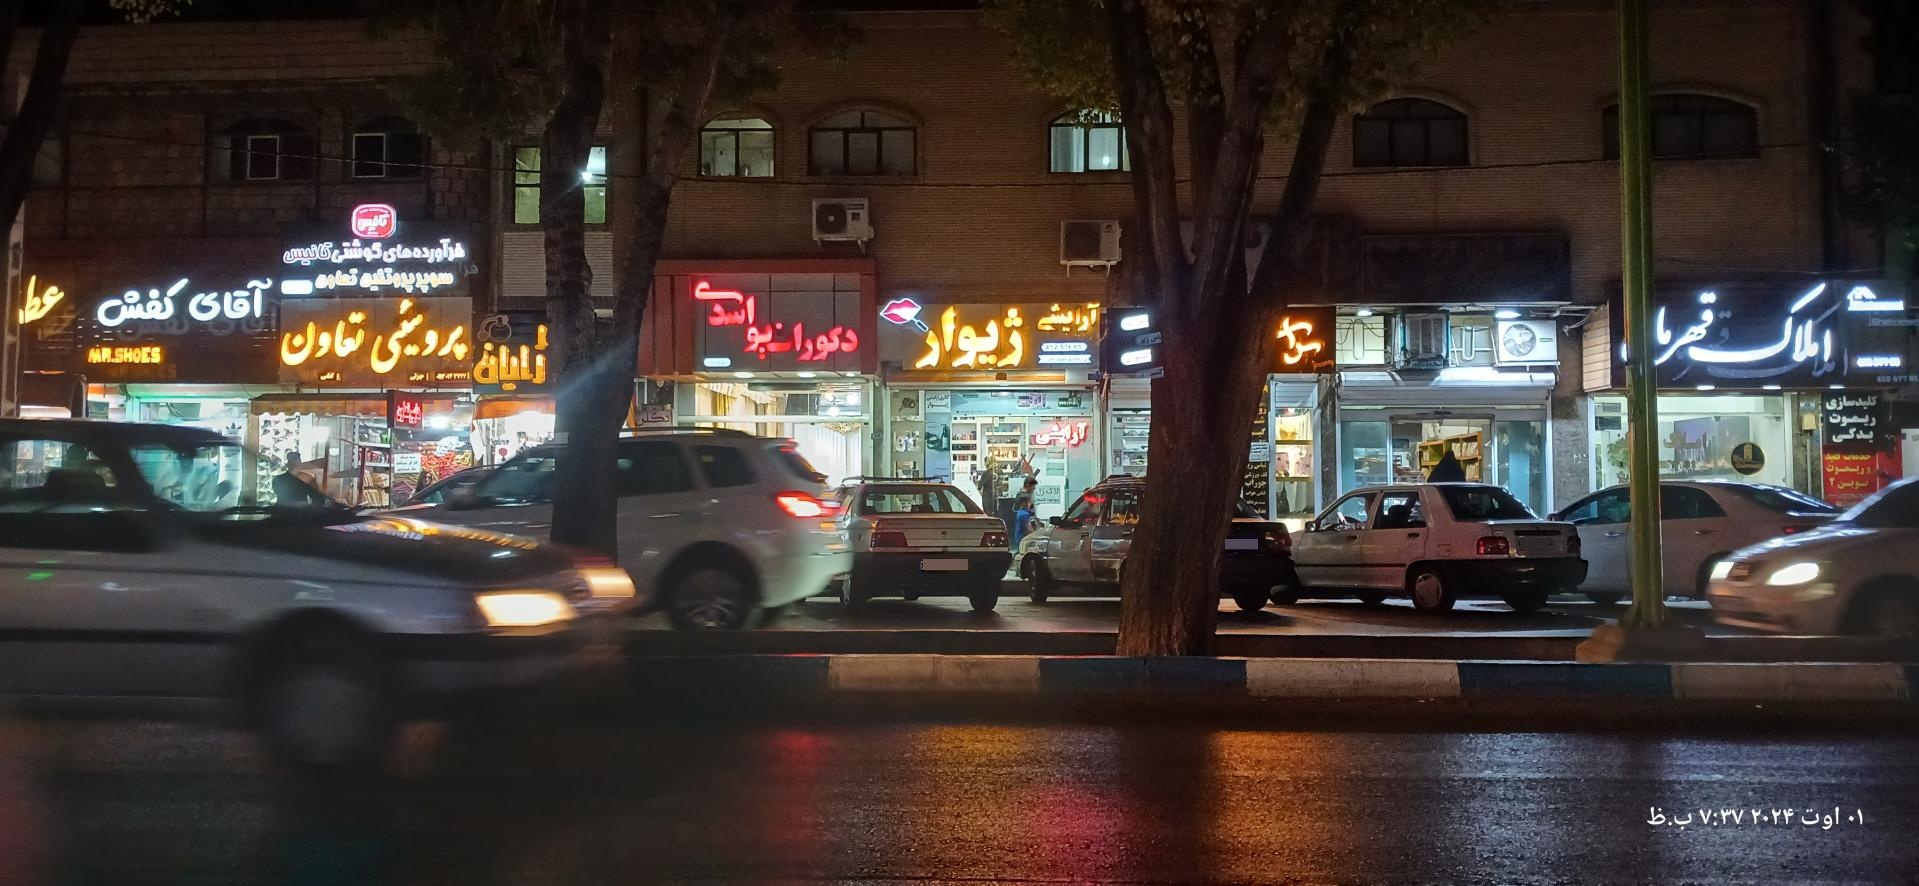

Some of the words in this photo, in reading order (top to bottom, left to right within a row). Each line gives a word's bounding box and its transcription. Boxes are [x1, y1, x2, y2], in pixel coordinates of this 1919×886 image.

[331, 238, 382, 263] گوشتی
[314, 267, 359, 290] تعاون
[415, 271, 454, 293] سوپر
[97, 277, 189, 327] کفش
[188, 277, 273, 322] آقای
[694, 280, 756, 327] اسدی
[1036, 302, 1100, 333] آرایشی
[1620, 291, 1717, 367] قهرما
[1687, 281, 1832, 363] املاک
[280, 311, 367, 367] تعاون
[914, 305, 1024, 370] ژیوار
[87, 346, 162, 364] MR.SHOES
[1828, 413, 1877, 427] ریموت
[1035, 421, 1088, 445] آرایشی
[1832, 427, 1874, 443] یدکی
[1825, 463, 1865, 475] ریموت
[1244, 478, 1267, 489] جوراب
